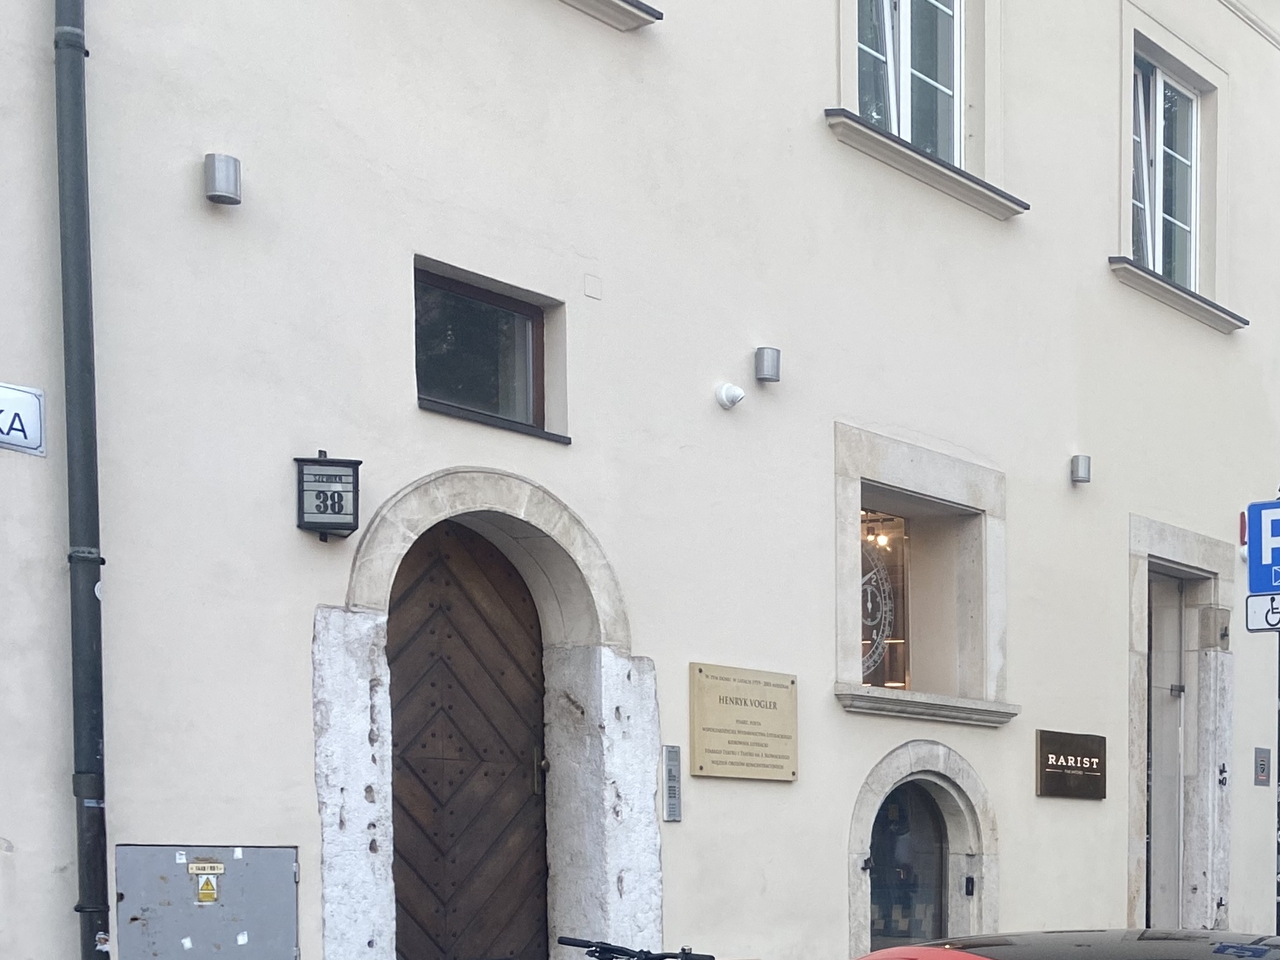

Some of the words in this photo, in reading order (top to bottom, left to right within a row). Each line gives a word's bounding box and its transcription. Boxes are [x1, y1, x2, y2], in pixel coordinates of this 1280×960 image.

[315, 491, 344, 514] 38
[718, 695, 749, 707] HENRYK
[749, 698, 778, 711] VOGLER
[1047, 754, 1099, 769] RARIST
